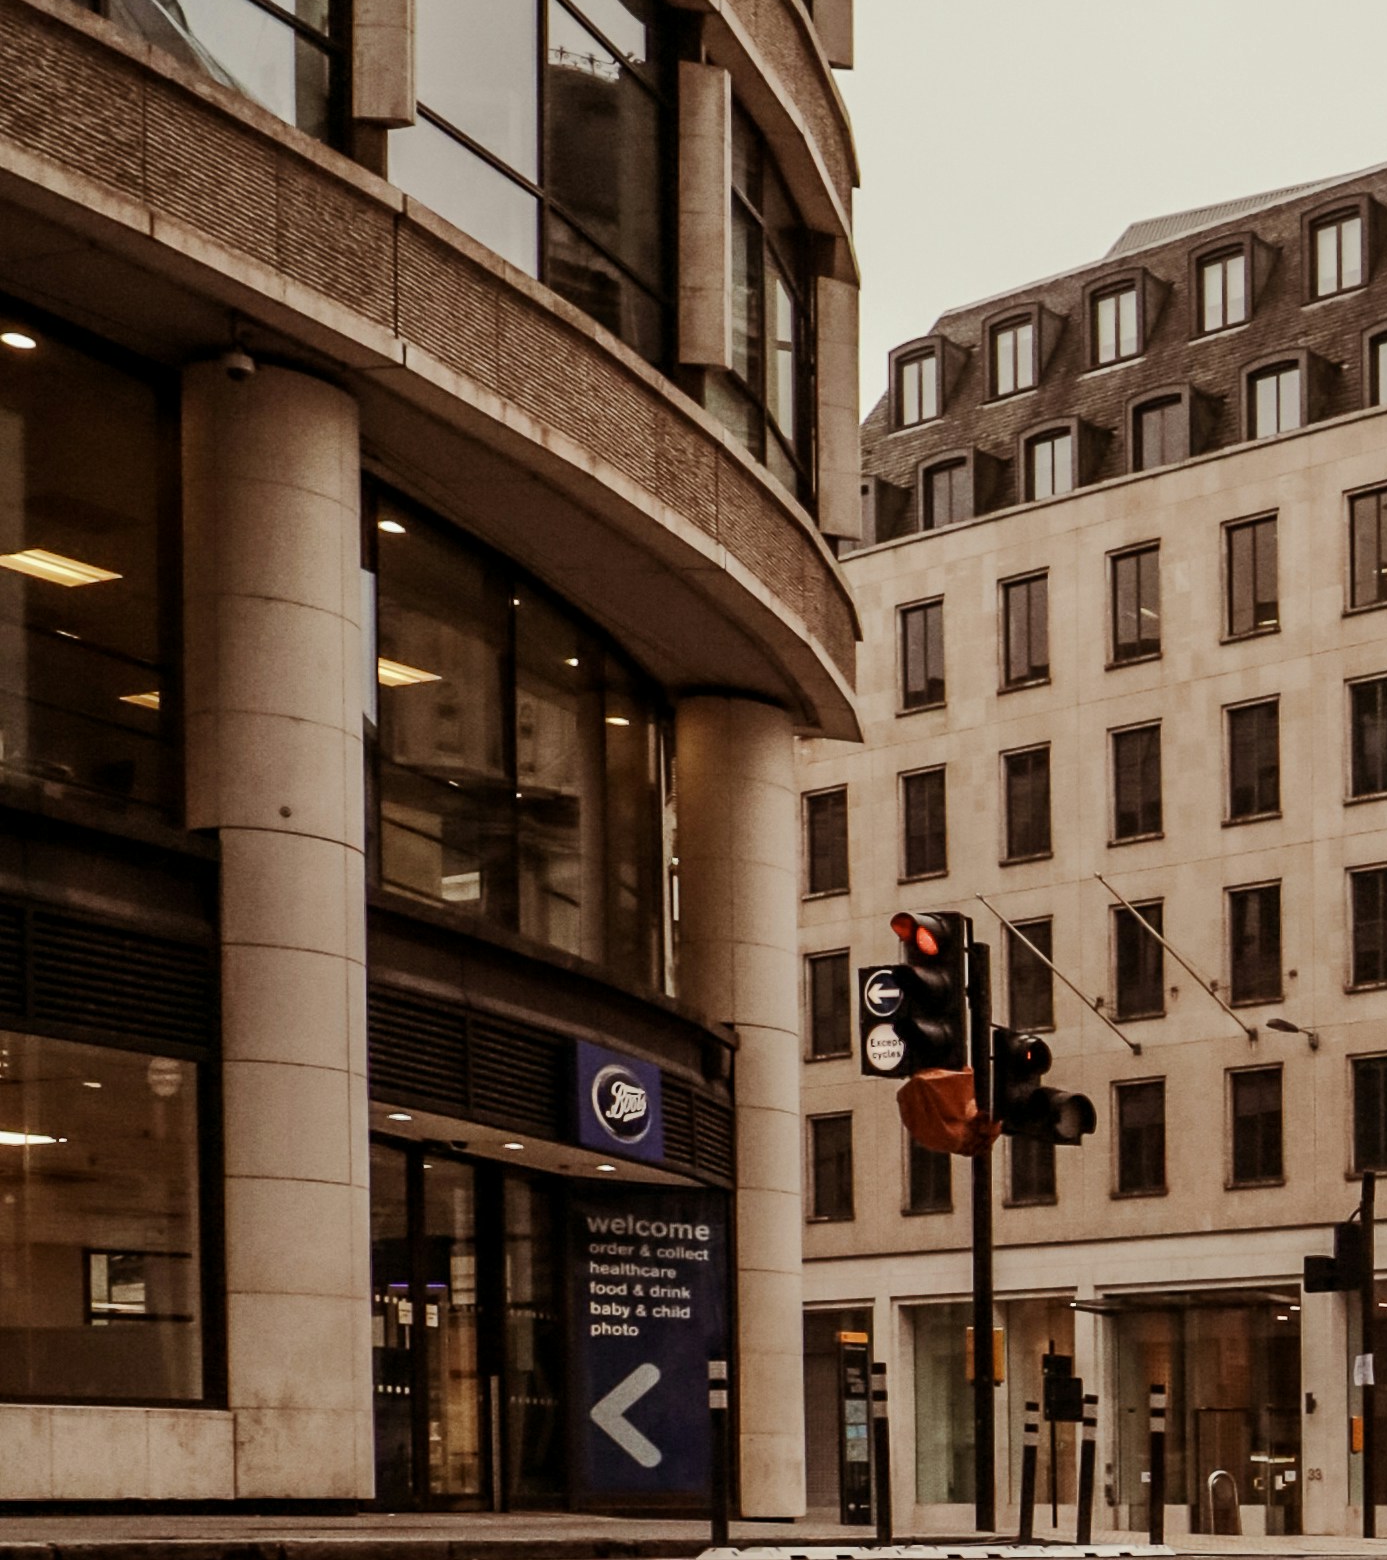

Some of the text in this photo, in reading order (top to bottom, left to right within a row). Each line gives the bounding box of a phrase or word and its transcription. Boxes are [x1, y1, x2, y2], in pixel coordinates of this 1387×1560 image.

[870, 1039, 903, 1047] Except
[872, 1050, 901, 1060] cycles
[606, 1081, 646, 1122] Boots
[587, 1215, 710, 1241] welcome
[589, 1243, 709, 1261] order & collect
[590, 1261, 676, 1278] healthcare
[590, 1281, 691, 1299] food & drink
[590, 1302, 690, 1318] baby & child
[590, 1322, 639, 1336] photo
[1308, 1468, 1322, 1481] 33
